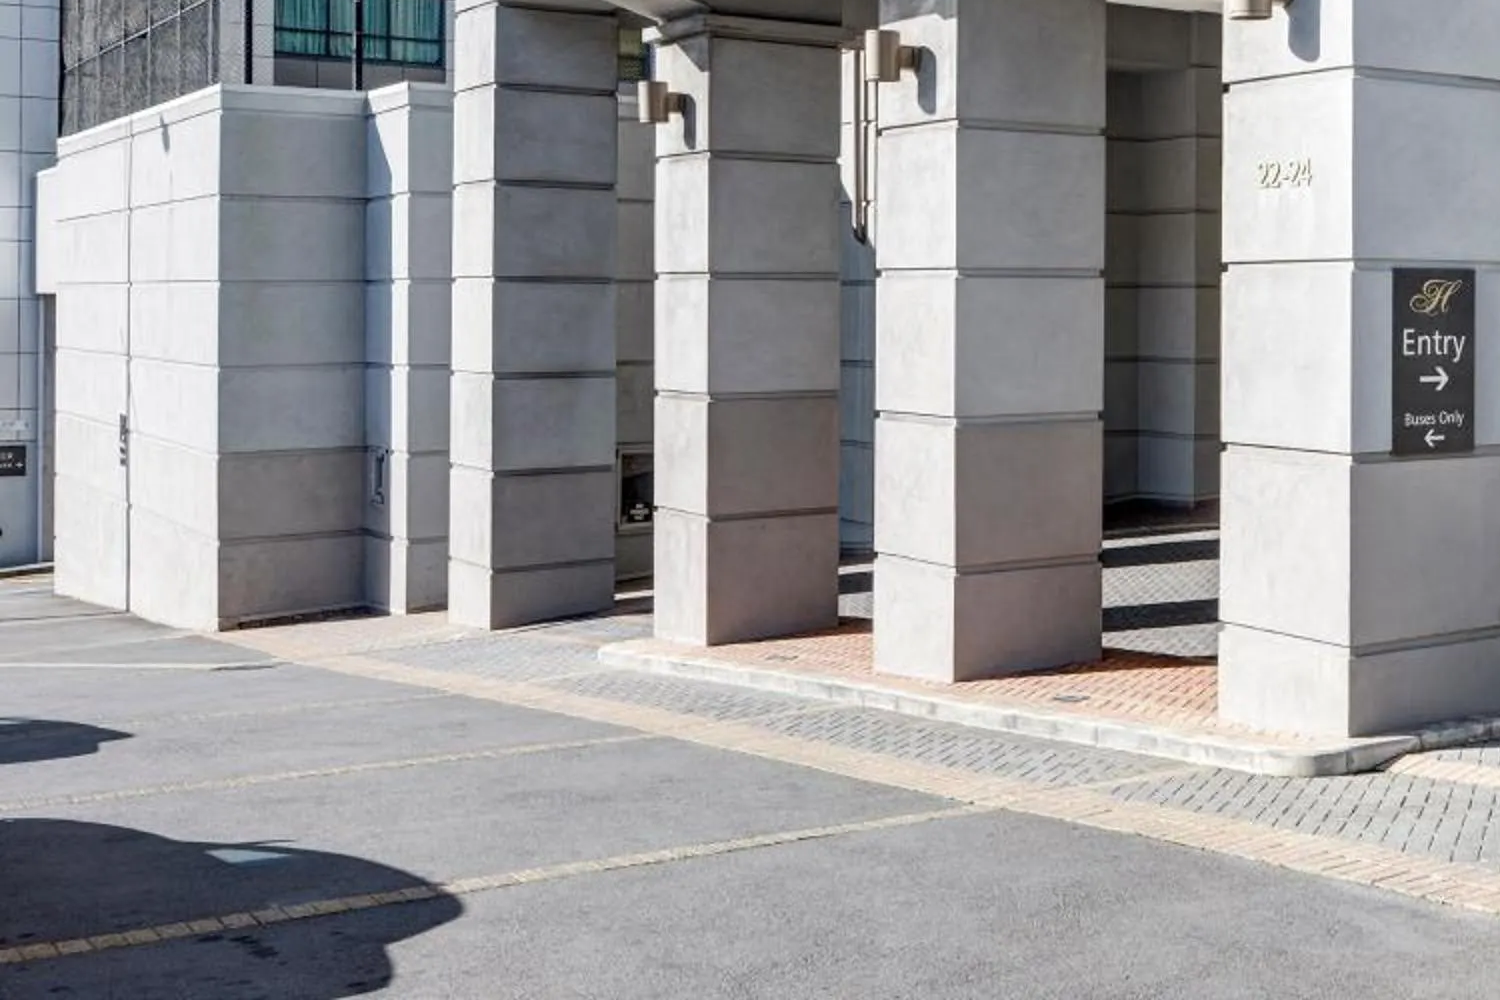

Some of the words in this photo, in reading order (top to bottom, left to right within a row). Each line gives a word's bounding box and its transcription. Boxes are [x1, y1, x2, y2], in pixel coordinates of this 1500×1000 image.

[1258, 158, 1312, 189] 22-24
[1402, 328, 1466, 363] Entry
[1404, 412, 1436, 427] Buses
[1439, 410, 1465, 427] Only
